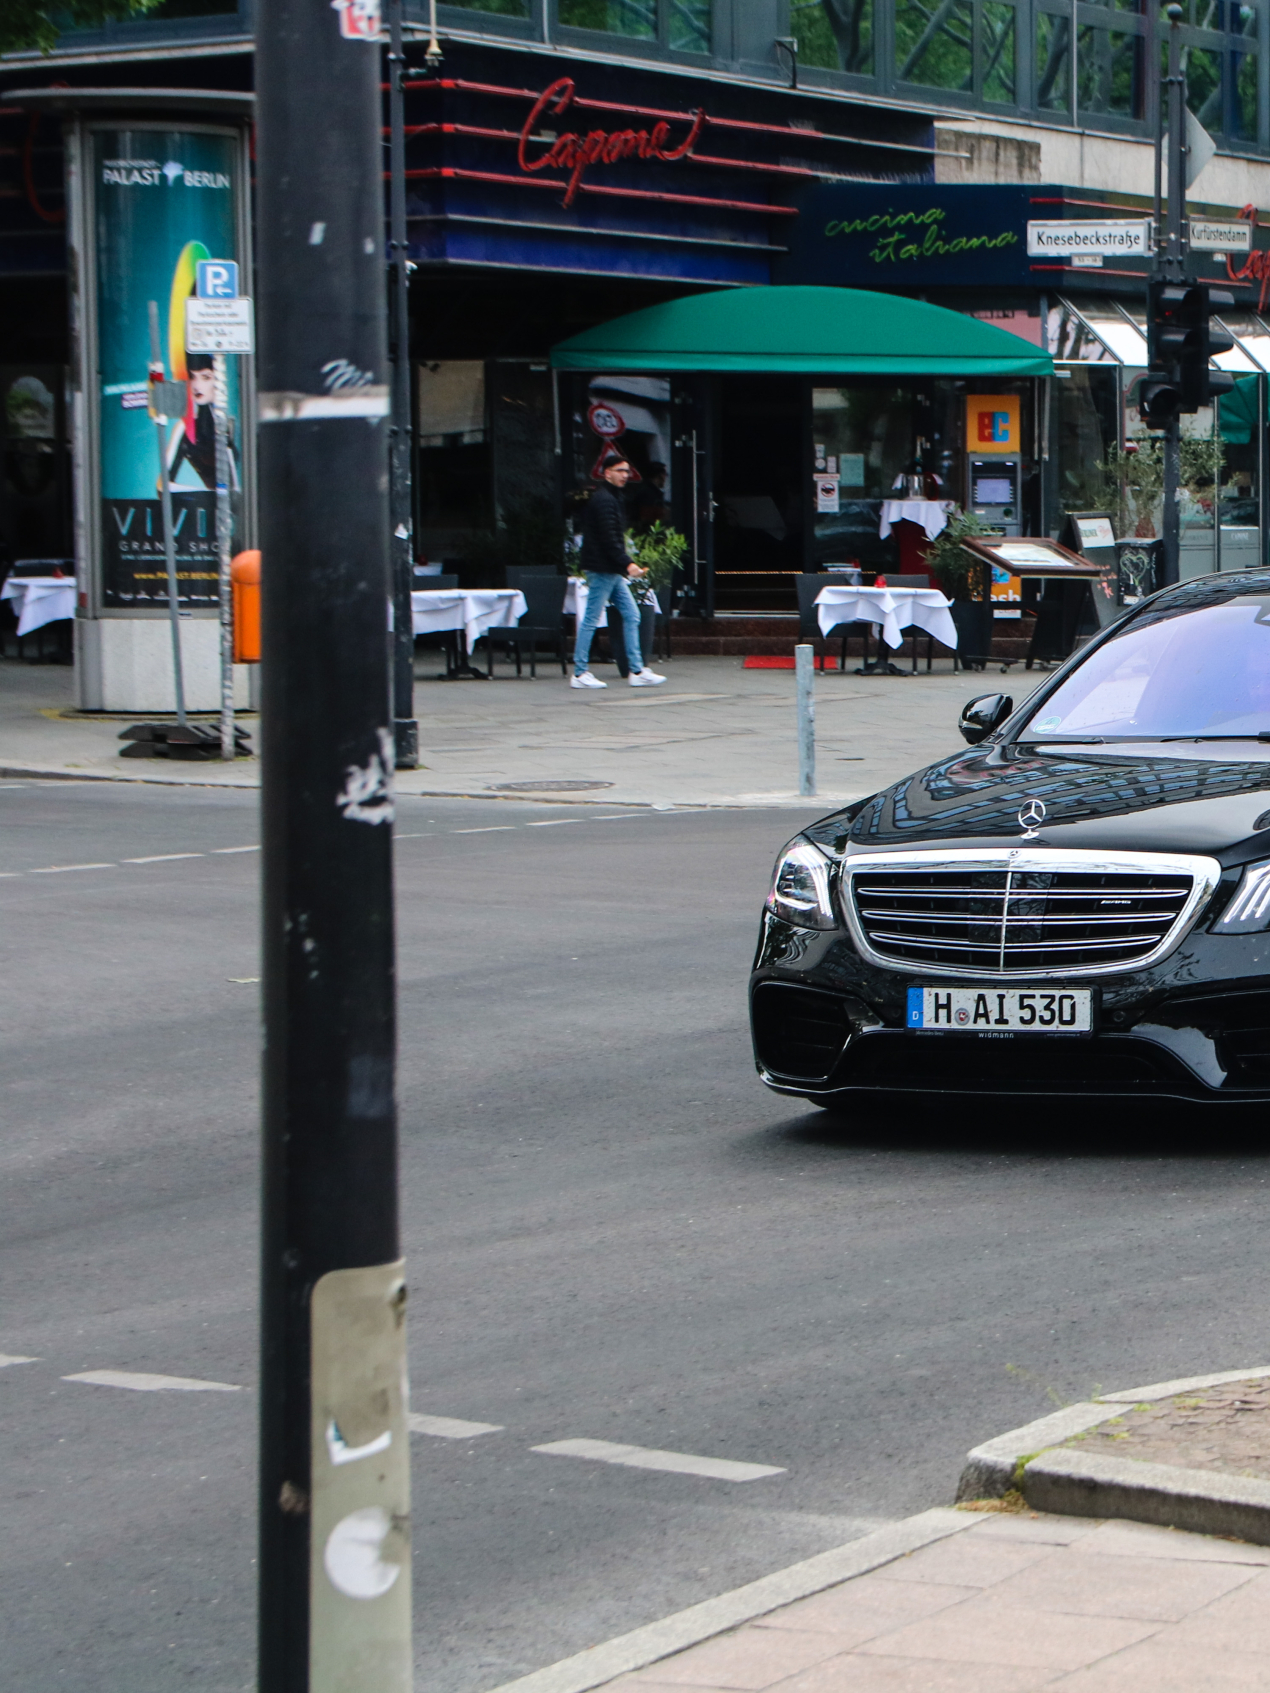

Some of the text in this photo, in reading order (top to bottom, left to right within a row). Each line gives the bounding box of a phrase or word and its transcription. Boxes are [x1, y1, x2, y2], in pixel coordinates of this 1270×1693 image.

[518, 77, 706, 209] Capone
[103, 169, 231, 188] PALAST BERLIN
[825, 208, 946, 236] cucina
[1191, 226, 1248, 243] Kurfürstendamm
[869, 224, 1018, 262] italiana
[1037, 231, 1140, 249] Knesebeckstraße
[206, 265, 229, 296] P
[934, 992, 1076, 1025] H AI 530
